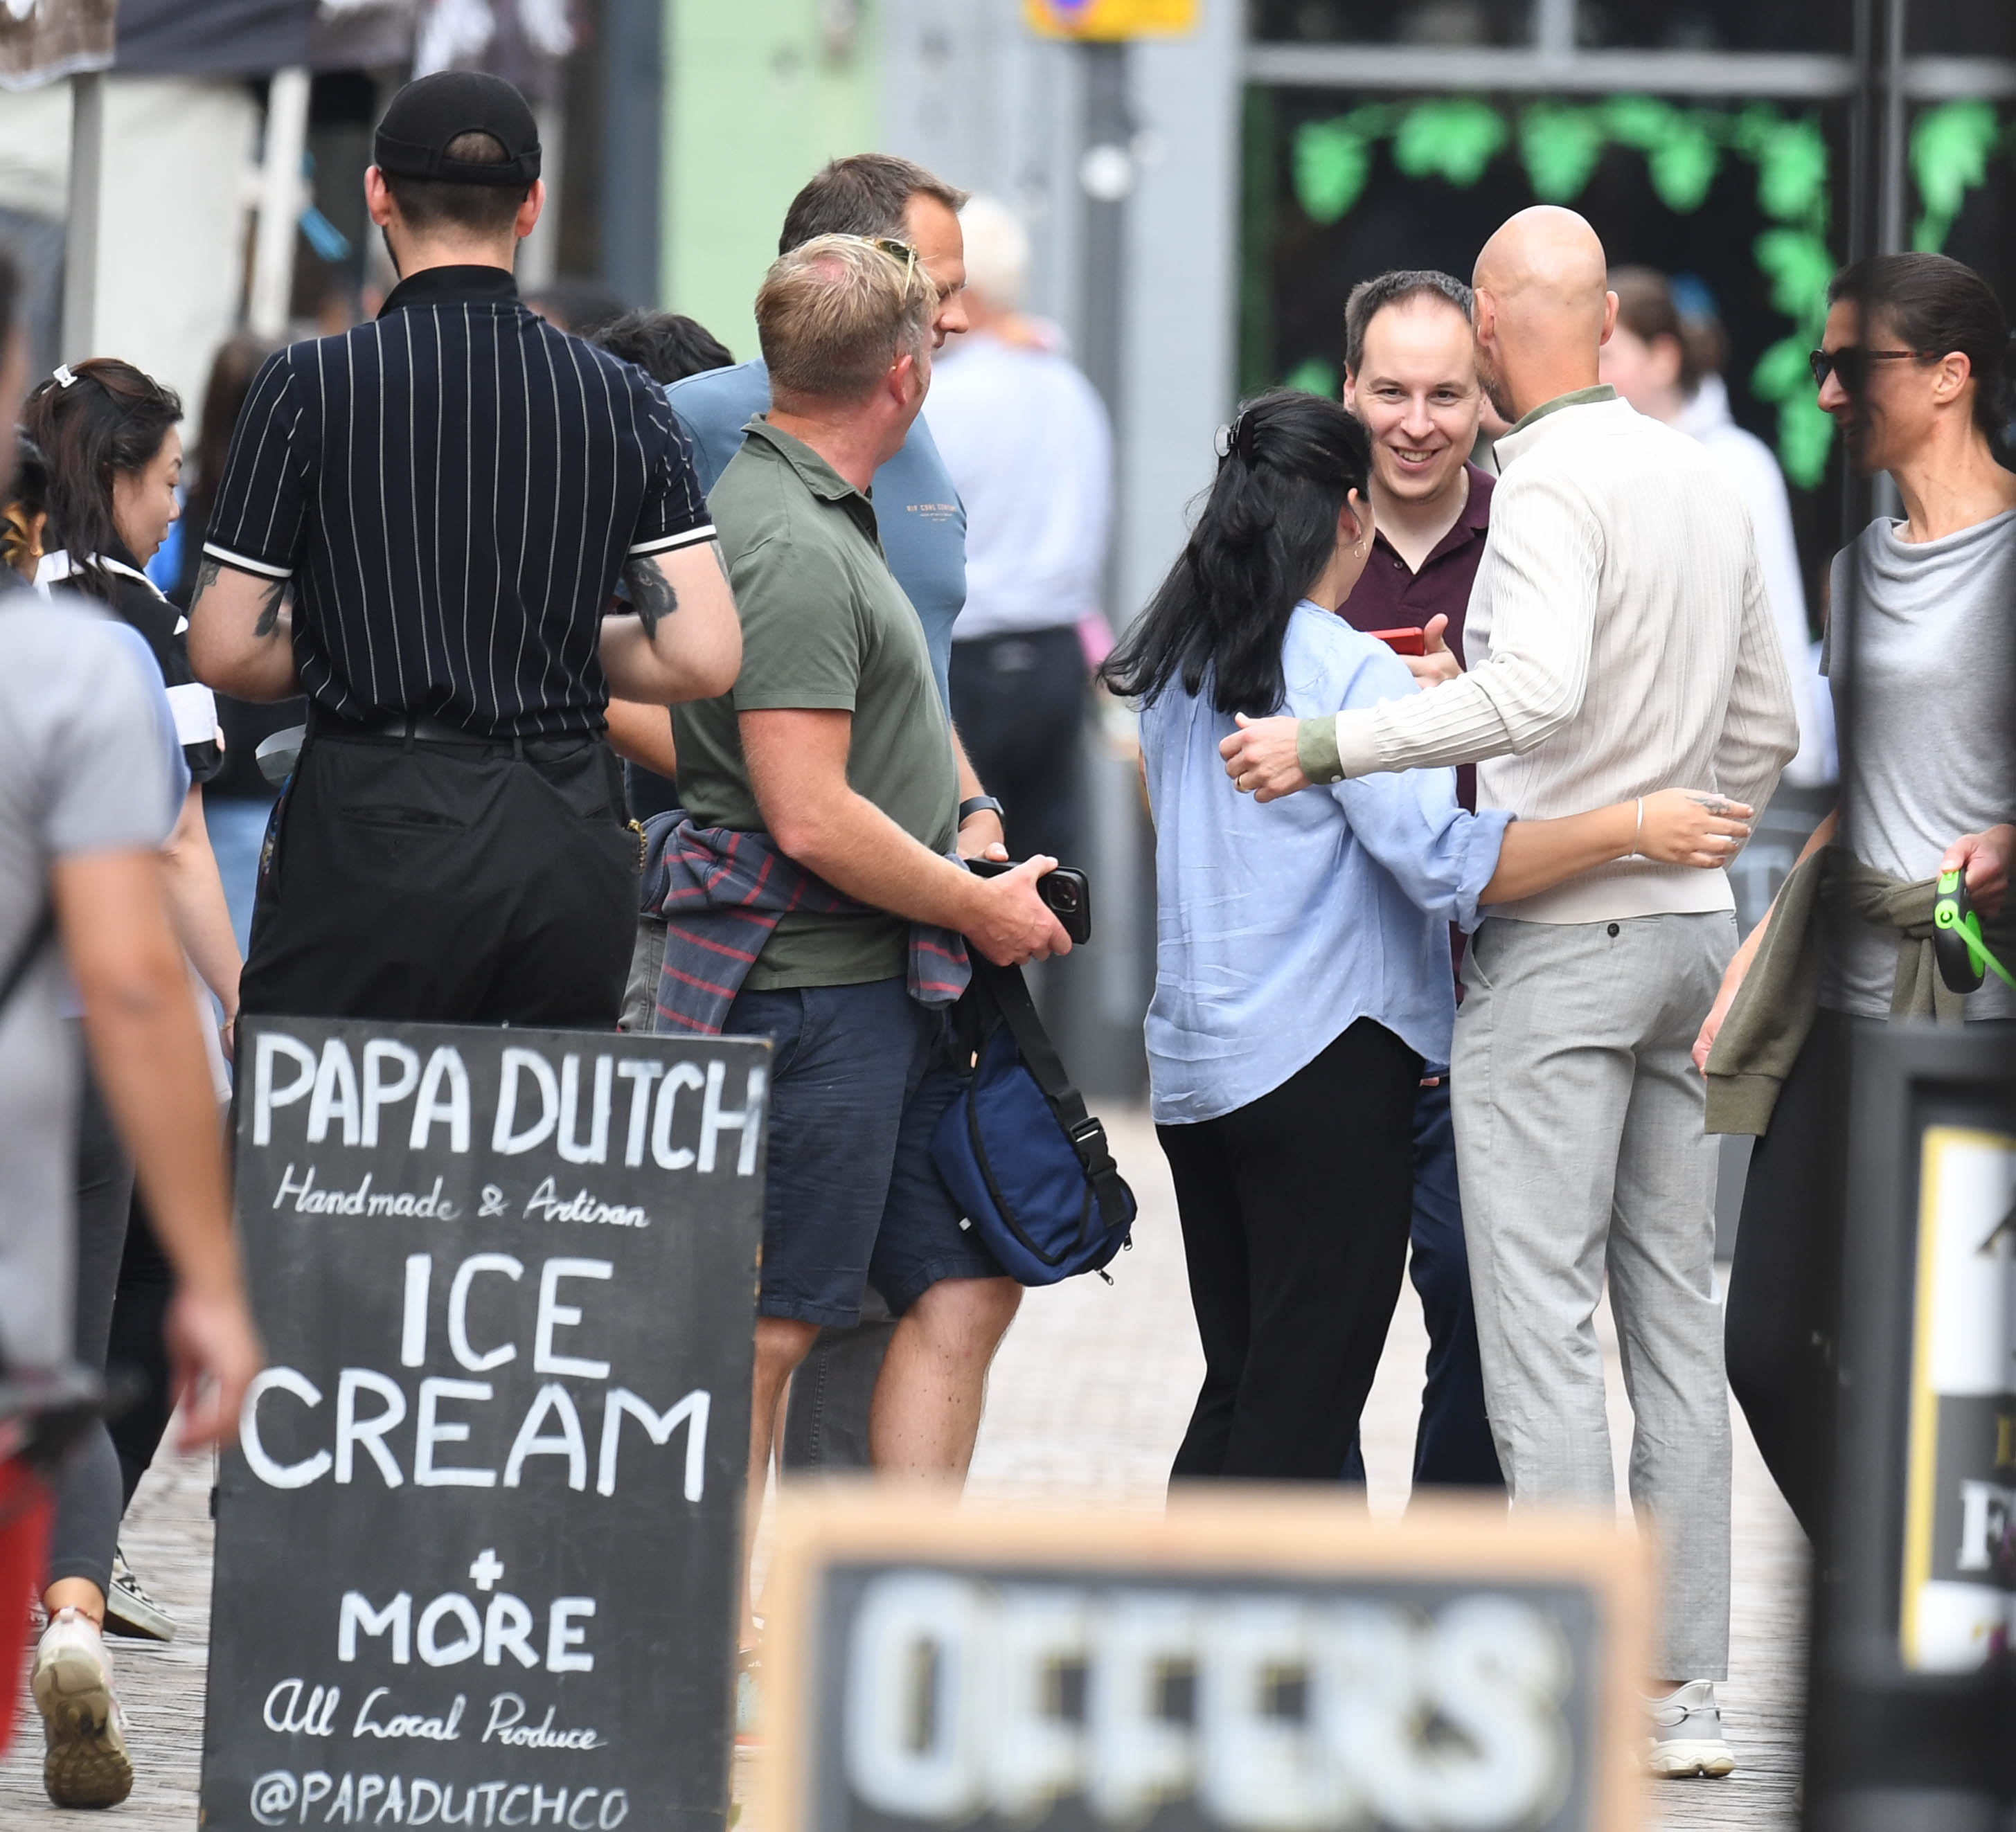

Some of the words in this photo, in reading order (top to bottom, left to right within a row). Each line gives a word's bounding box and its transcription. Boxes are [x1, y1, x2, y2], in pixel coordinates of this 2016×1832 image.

[253, 1032, 470, 1153] PAPA
[492, 1048, 765, 1176] DUTCH
[273, 1162, 462, 1221] Handmade
[478, 1183, 510, 1216] &
[523, 1175, 650, 1228] Artisan
[401, 1252, 614, 1379] ICE
[239, 1366, 712, 1502] CREAM
[470, 1548, 504, 1590] +
[338, 1590, 596, 1672] MORE
[352, 1686, 466, 1740] Local
[483, 1692, 608, 1750] Produce
[842, 1568, 1568, 1831] OFFERS
[250, 1770, 630, 1830] @PAPADUTCHCO
